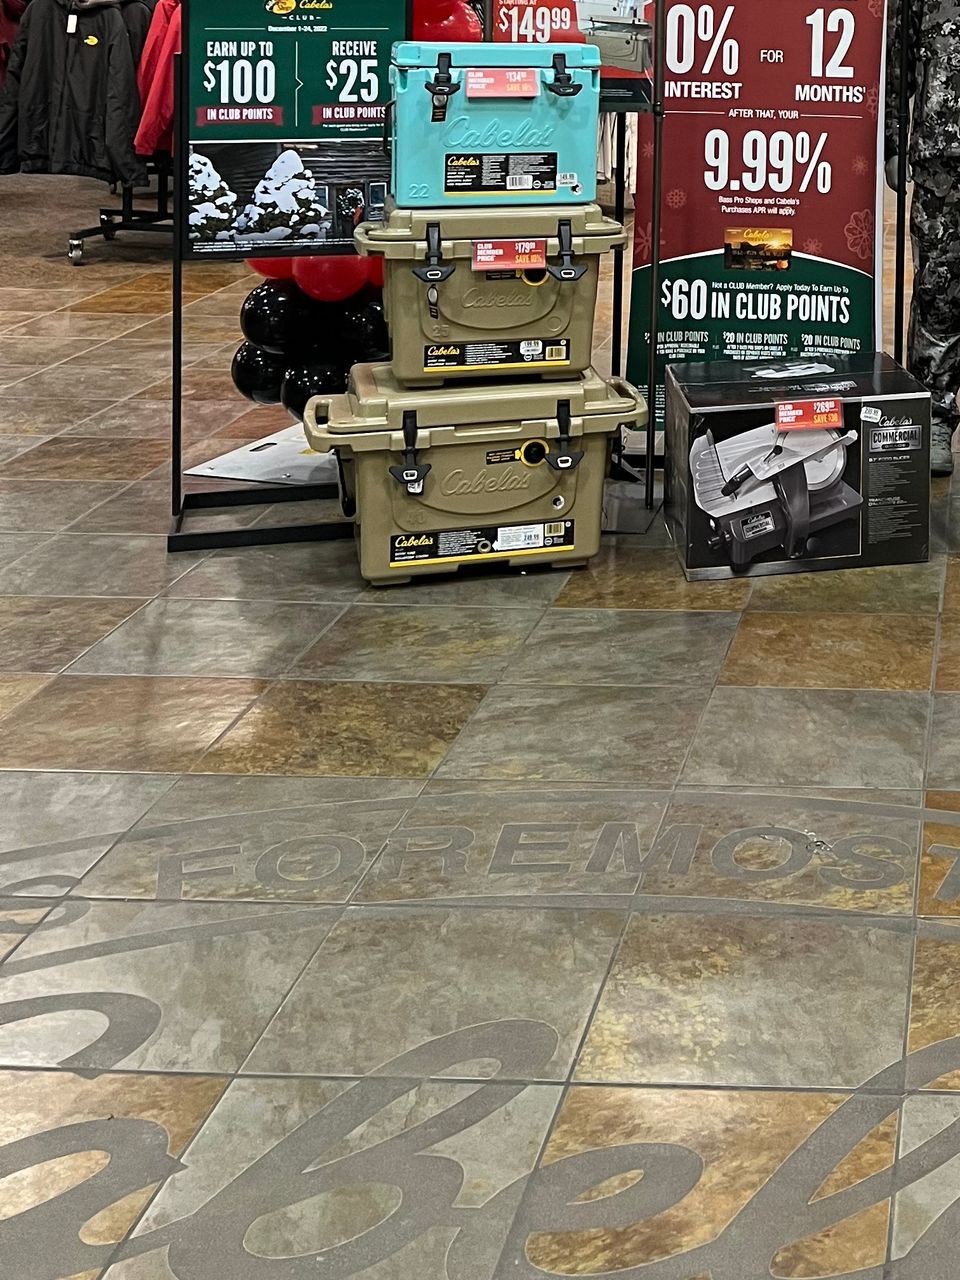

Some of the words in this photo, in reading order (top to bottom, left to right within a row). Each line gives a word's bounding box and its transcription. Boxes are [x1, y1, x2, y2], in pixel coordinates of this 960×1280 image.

[665, 3, 739, 76] 0%
[806, 7, 855, 78] 12
[206, 41, 237, 57] EARN
[240, 41, 256, 57] UP
[258, 41, 274, 57] TO
[332, 40, 377, 56] RECEIVE
[760, 49, 784, 63] FOR
[203, 59, 276, 104] $100
[325, 59, 379, 103] $25
[664, 81, 742, 99] INTEREST
[207, 108, 216, 121] IN
[218, 108, 240, 120] CLUB
[241, 108, 273, 121] POINTS
[322, 107, 332, 119] IN
[334, 107, 355, 119] CLUB
[356, 107, 386, 118] POINTS
[728, 109, 754, 118] AFTER
[755, 109, 777, 119] THAT,
[778, 110, 799, 119] YOUR
[443, 115, 555, 149] Cabela's
[704, 128, 832, 194] 9.99%
[409, 183, 430, 199] 22
[718, 196, 733, 204] Bass
[745, 197, 763, 205] Shops
[721, 205, 752, 214] Purchases
[753, 206, 766, 214] APR
[711, 281, 722, 289] Not
[728, 282, 745, 290] CLUB
[746, 282, 774, 290] Member?
[776, 283, 793, 292] Apply
[794, 283, 811, 292] Today
[820, 284, 833, 292] Earn
[834, 285, 842, 294] Up
[842, 286, 849, 294] To
[461, 287, 535, 309] Cabela's
[661, 278, 708, 321] $60
[711, 291, 730, 319] IN
[735, 292, 781, 320] CLUB
[786, 293, 851, 324] POINTS
[432, 324, 450, 338] 25
[657, 331, 665, 342] IN
[665, 331, 682, 342] CLUB
[684, 331, 709, 342] POINTS
[723, 331, 735, 343] $20
[736, 332, 744, 344] IN
[745, 333, 763, 344] CLUB
[763, 333, 788, 345] POINTS
[801, 333, 813, 346] $20
[814, 334, 822, 346] IN
[823, 335, 840, 347] CLUB
[840, 336, 861, 350] POINTS
[873, 429, 918, 443] COMMERCIAL
[441, 467, 530, 496] Cabela's
